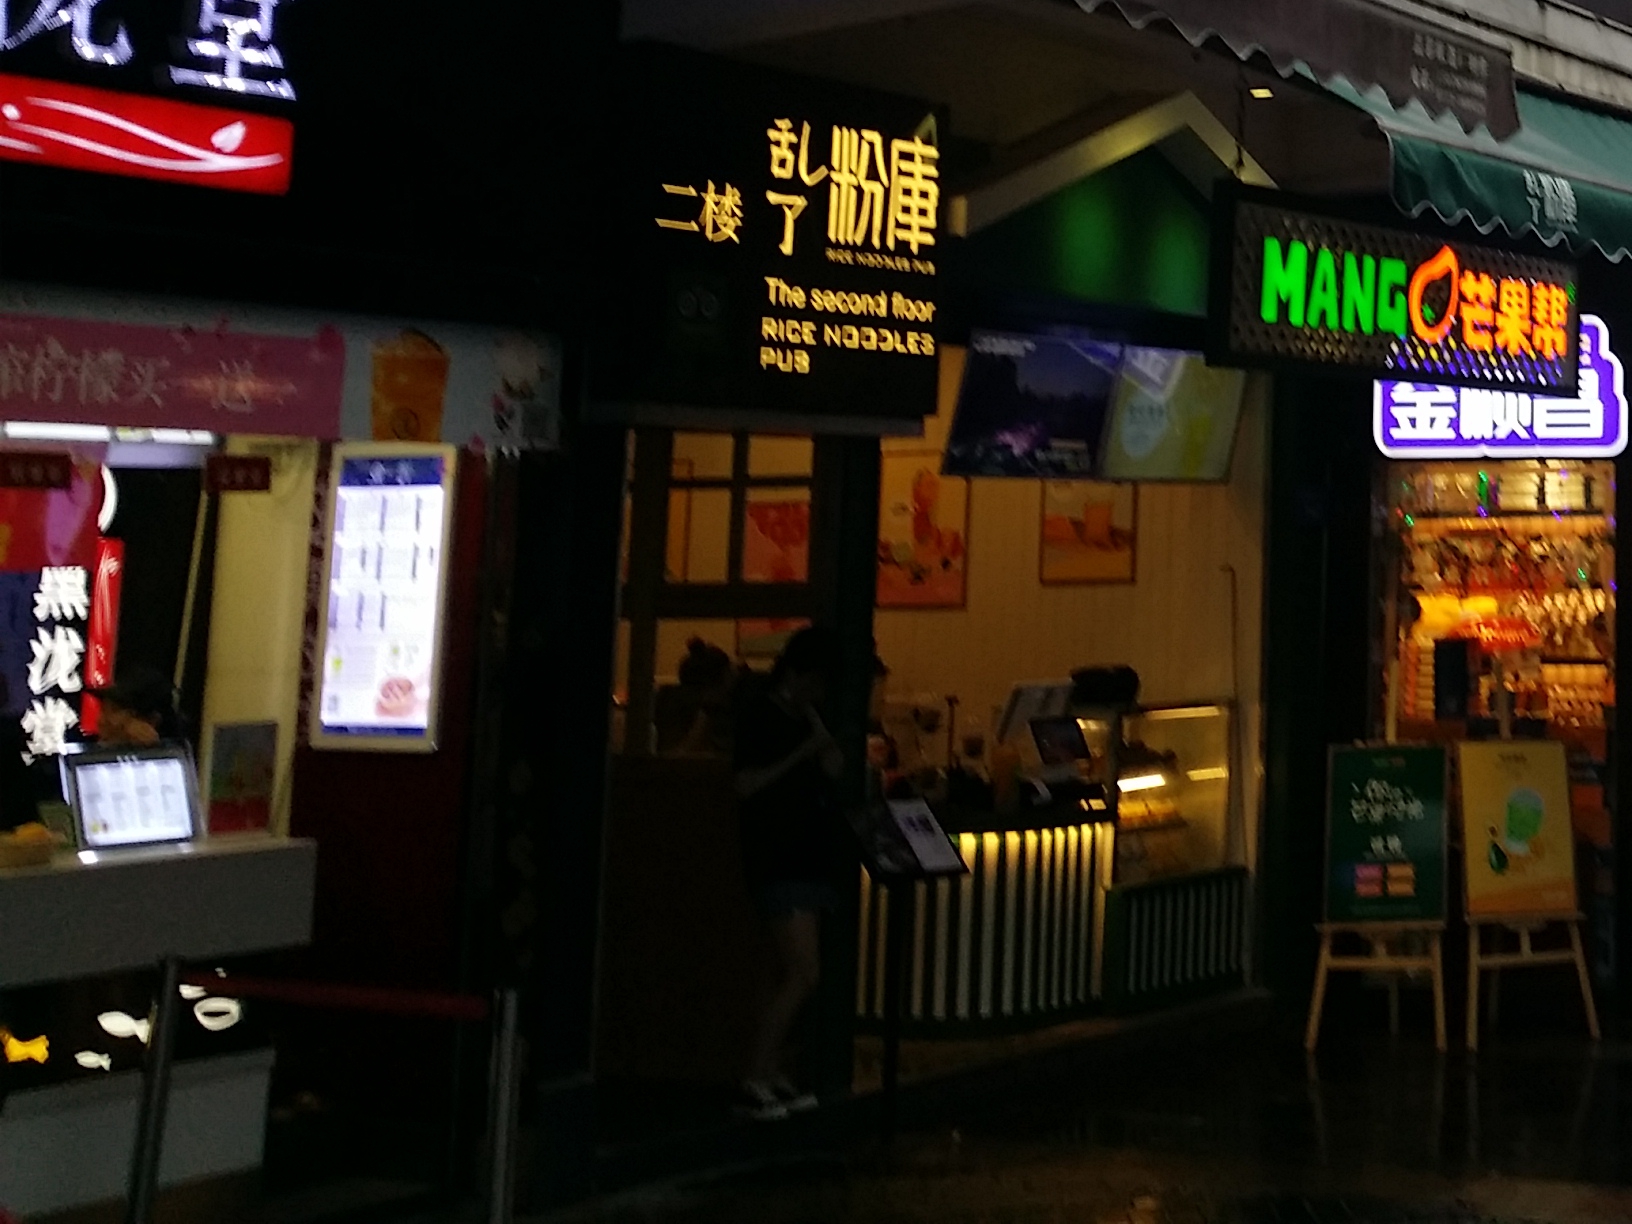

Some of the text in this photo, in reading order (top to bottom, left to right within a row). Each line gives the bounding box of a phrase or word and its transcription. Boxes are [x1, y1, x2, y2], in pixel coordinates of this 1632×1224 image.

[655, 178, 744, 245] 二楼
[764, 276, 937, 323] The second floor
[761, 316, 817, 346] RICE
[823, 323, 935, 356] NOODLES
[760, 346, 811, 375] PUB
